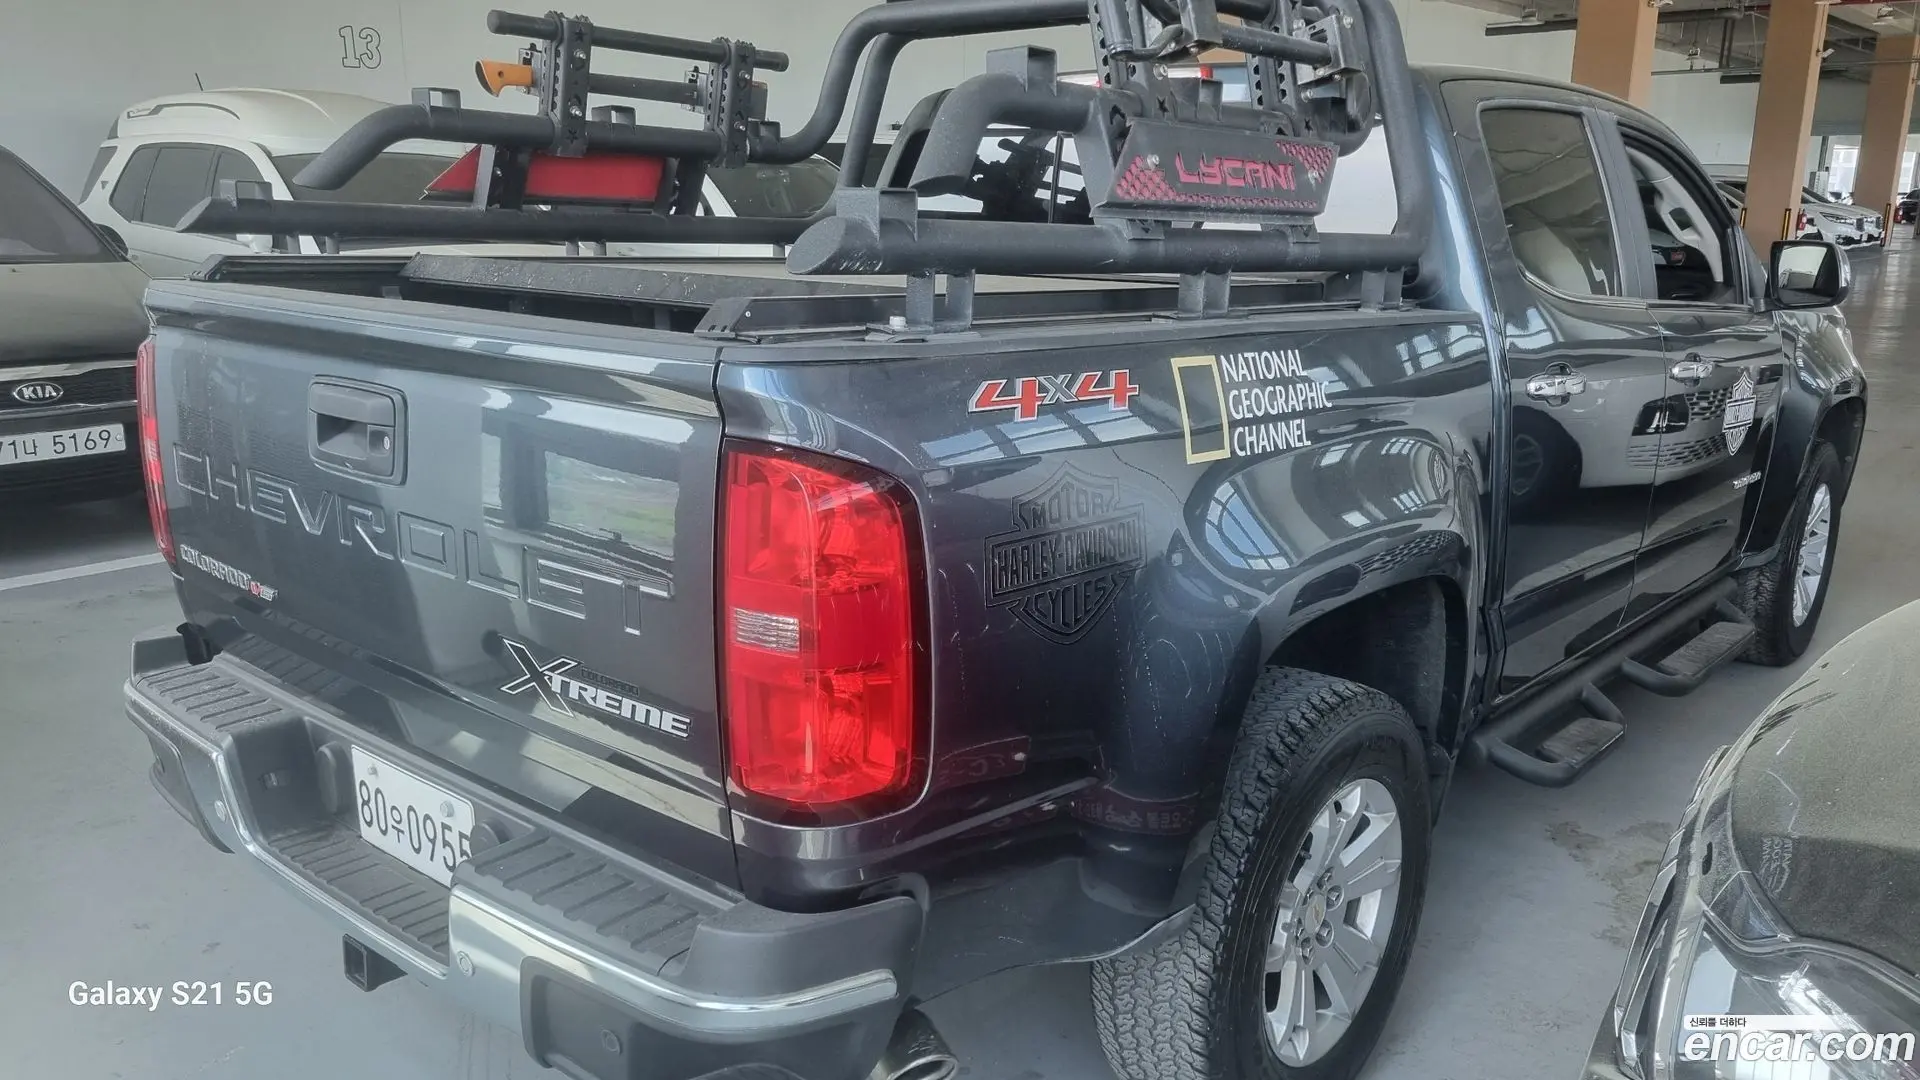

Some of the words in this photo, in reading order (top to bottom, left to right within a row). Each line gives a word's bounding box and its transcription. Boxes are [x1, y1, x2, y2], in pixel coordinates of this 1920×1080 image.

[338, 25, 381, 69] 13
[1219, 349, 1308, 383] NATIONAL
[21, 385, 58, 400] KIA
[1227, 381, 1333, 421] GEOGRAPHIC
[52, 429, 111, 455] 5169
[1233, 418, 1312, 458] CHANNEL
[1031, 481, 1106, 529] MOTOR
[173, 444, 676, 636] CHEVROLET
[995, 519, 1140, 589] HARLEY-DAVIDSON
[180, 544, 251, 591] COLORADO
[1033, 576, 1108, 629] CYCLES
[500, 638, 692, 738] XTREME
